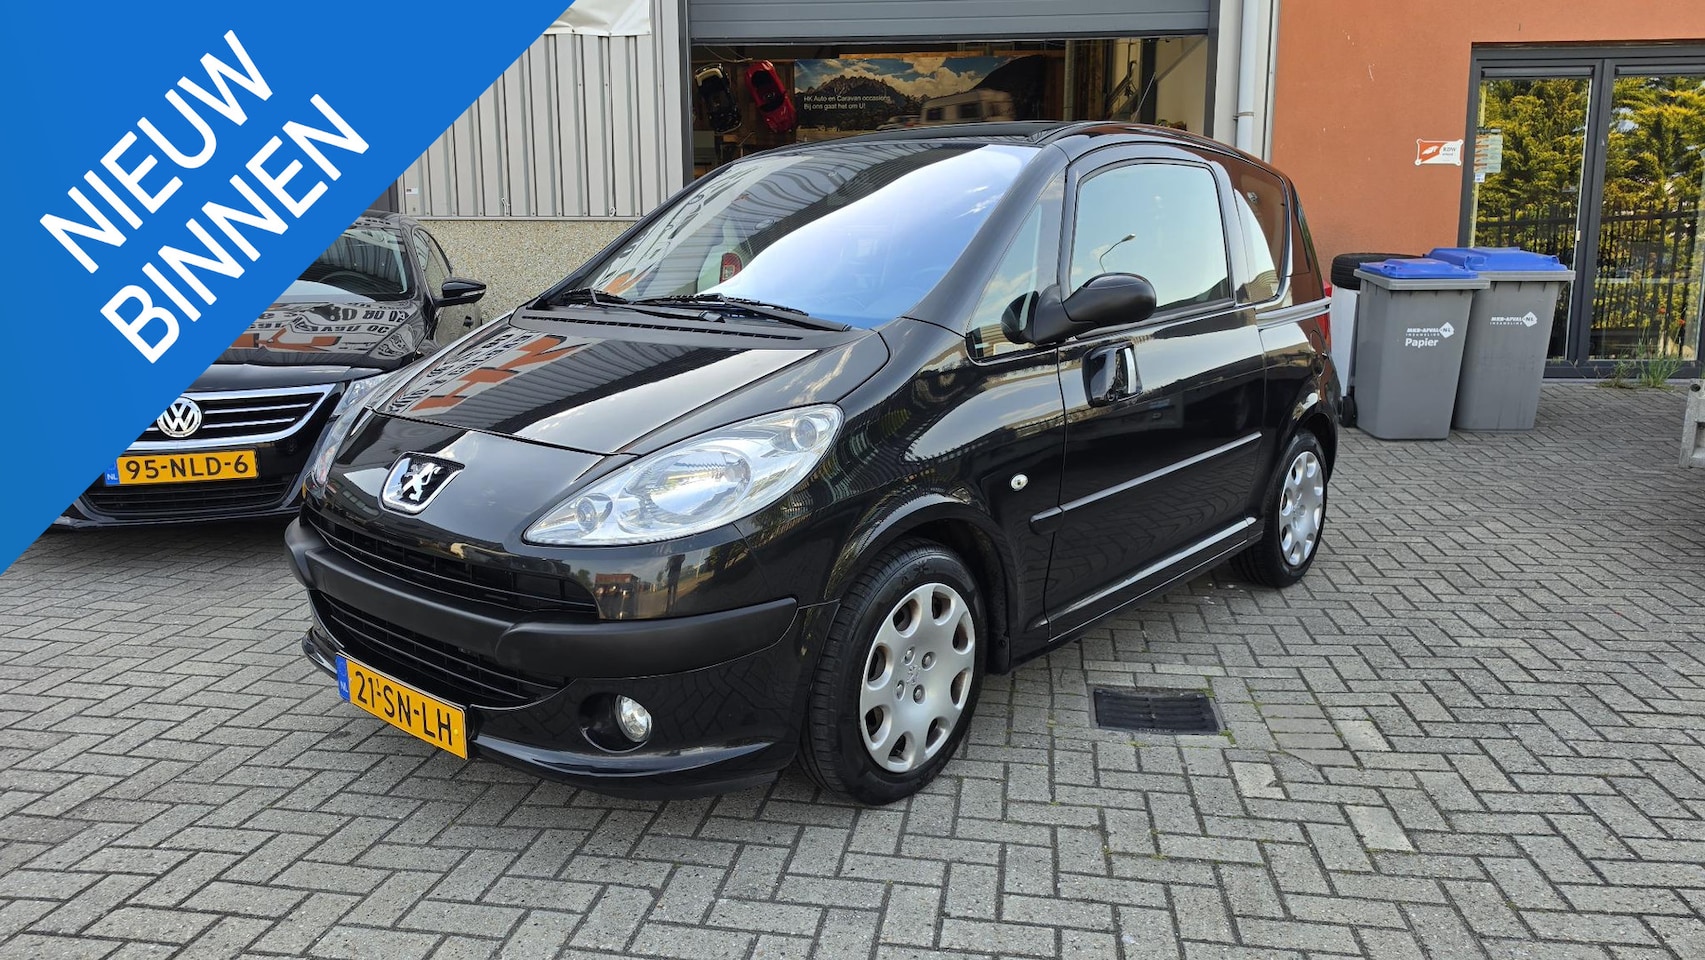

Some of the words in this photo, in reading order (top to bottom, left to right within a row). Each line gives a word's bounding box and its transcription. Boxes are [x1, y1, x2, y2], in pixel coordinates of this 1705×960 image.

[803, 103, 812, 111] Bij
[824, 103, 837, 111] gaat
[1405, 337, 1439, 349] Papier
[106, 472, 119, 481] NL
[125, 454, 249, 480] 95-NLD-6
[340, 681, 349, 694] NL
[355, 671, 453, 746] 21-SN-LH
